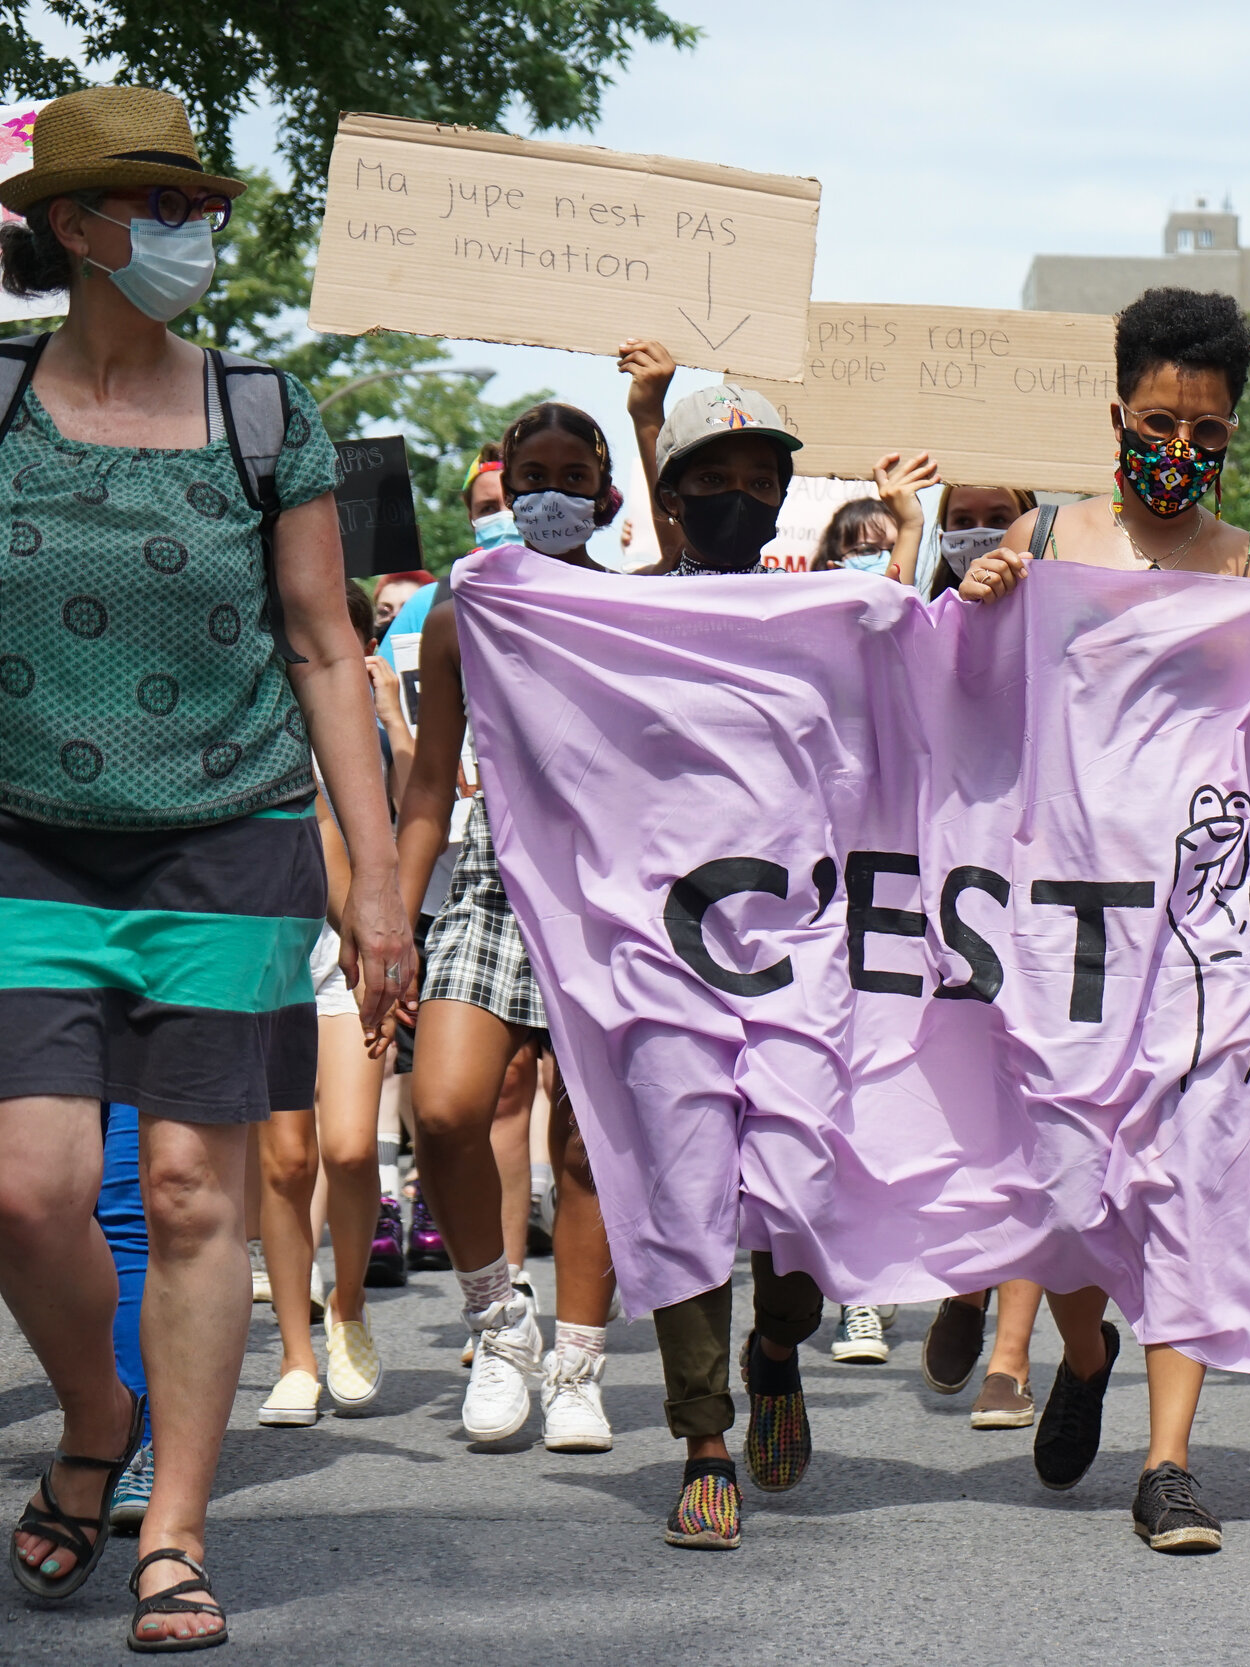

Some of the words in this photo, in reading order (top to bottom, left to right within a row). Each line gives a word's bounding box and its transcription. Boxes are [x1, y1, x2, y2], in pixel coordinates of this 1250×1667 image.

[355, 157, 408, 196] Ma
[439, 176, 525, 220] jupe
[555, 193, 646, 228] n'est
[676, 211, 738, 247] PAS
[346, 218, 417, 247] une
[453, 234, 650, 282] invitation
[808, 316, 898, 352] pists
[928, 325, 1010, 361] rape
[809, 356, 886, 386] eople
[919, 360, 986, 389] NOT
[541, 501, 559, 513] will
[662, 850, 1155, 1023] C'EST
